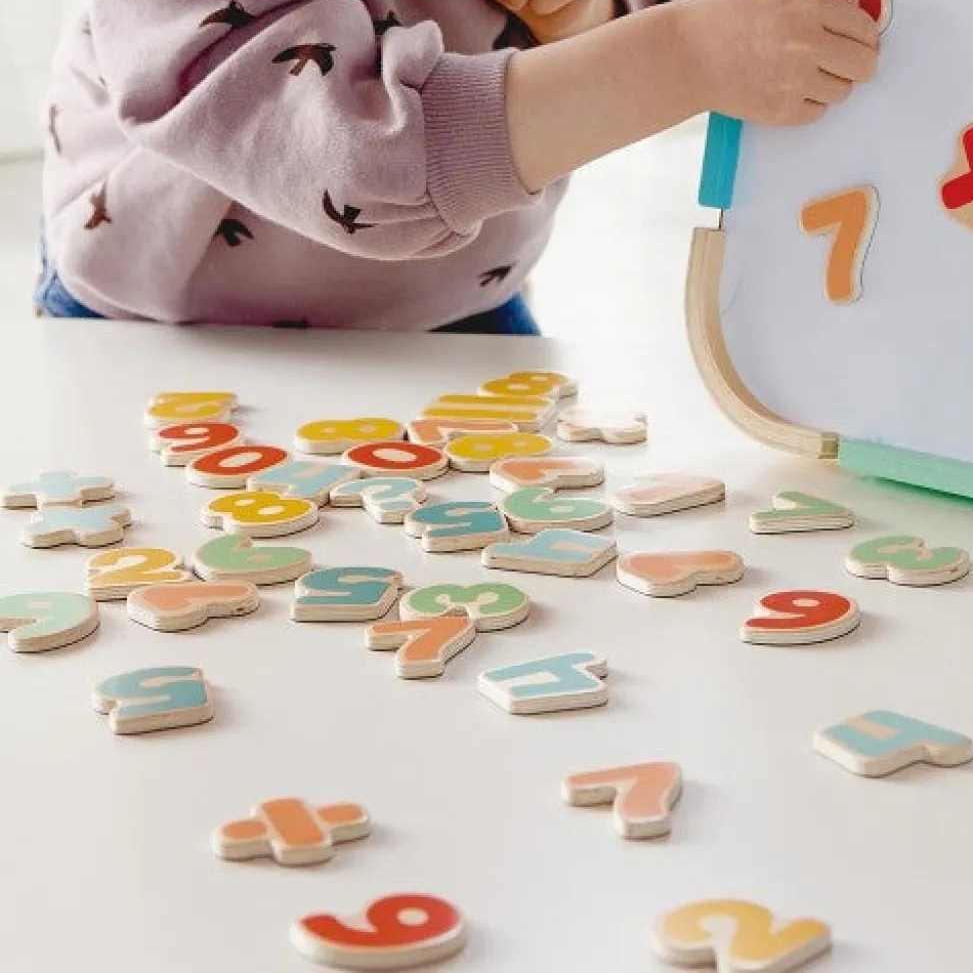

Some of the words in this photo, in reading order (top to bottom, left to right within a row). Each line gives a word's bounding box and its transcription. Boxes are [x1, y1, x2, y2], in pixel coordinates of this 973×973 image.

[801, 190, 868, 301] 7
[298, 418, 403, 441] 8
[448, 434, 551, 460] 8
[206, 492, 311, 522] 8
